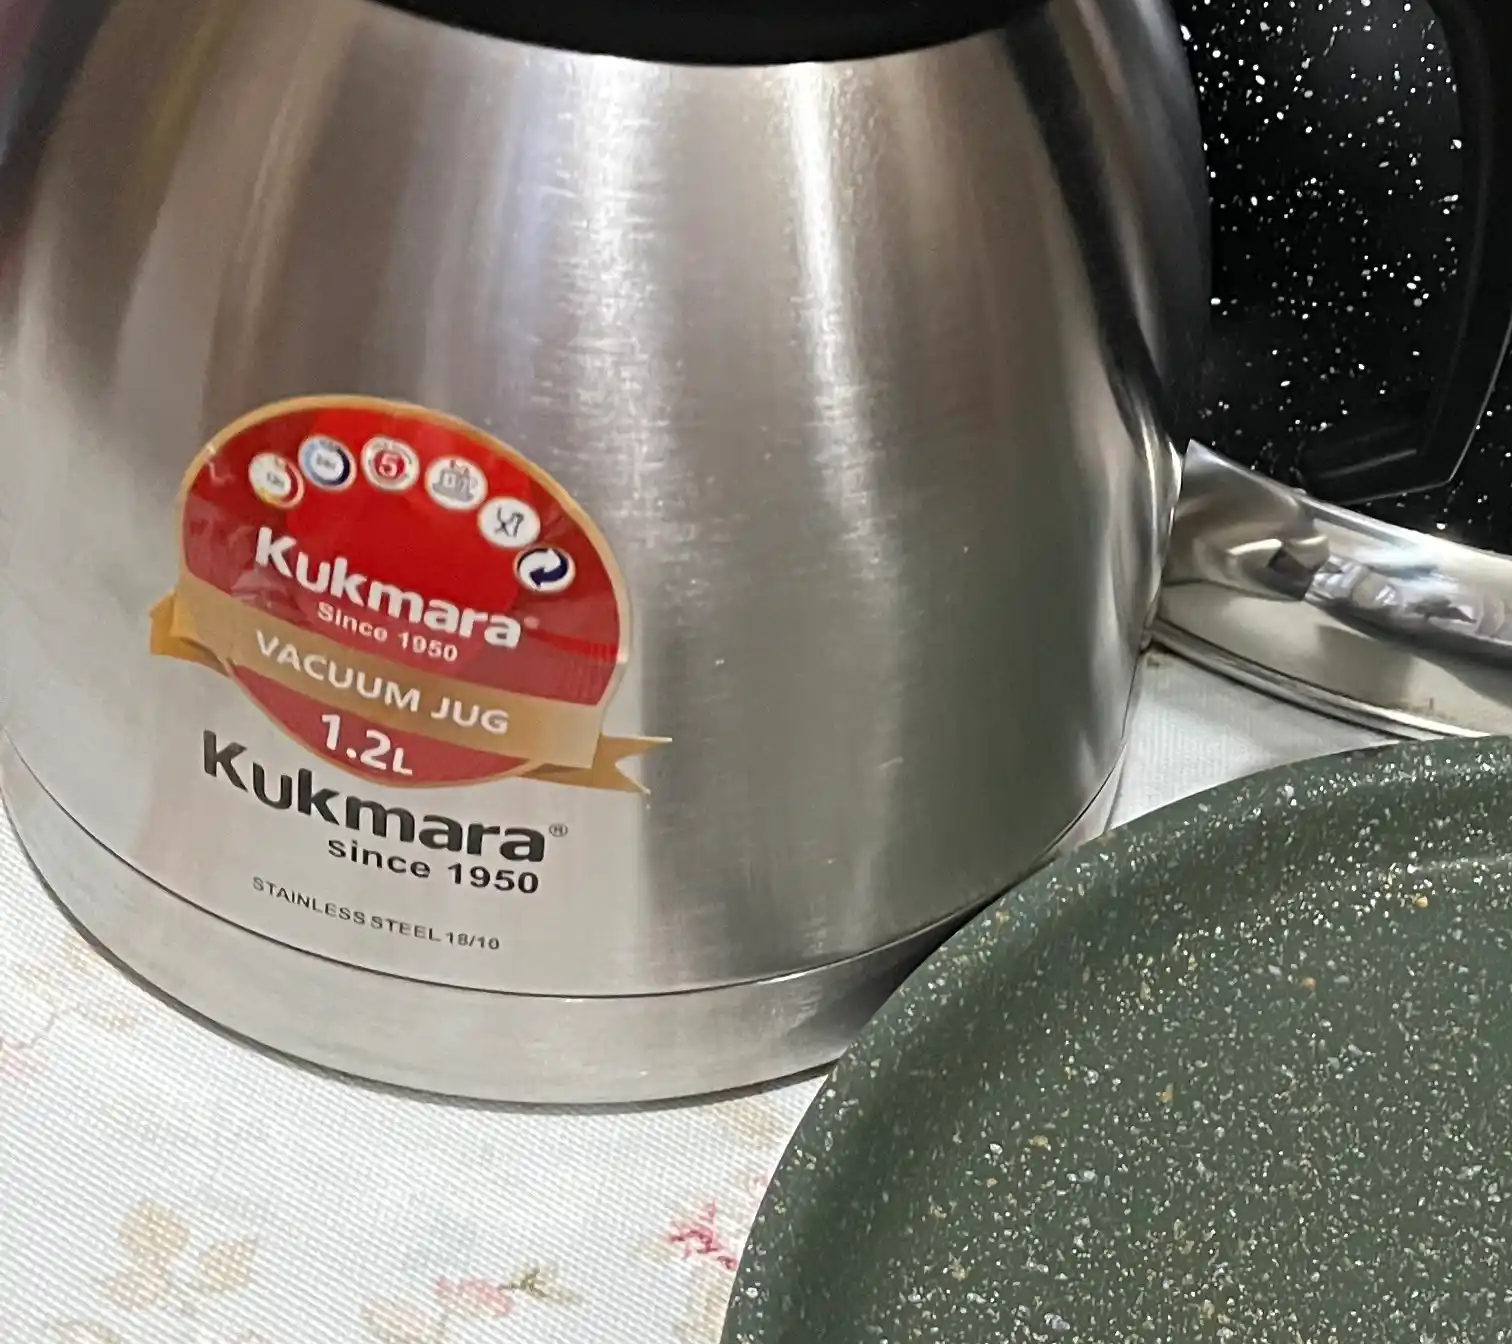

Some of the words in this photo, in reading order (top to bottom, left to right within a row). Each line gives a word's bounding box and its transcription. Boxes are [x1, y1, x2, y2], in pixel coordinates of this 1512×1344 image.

[254, 526, 522, 649] Kukmara
[316, 600, 388, 643] Since
[398, 631, 458, 663] 1950
[255, 628, 421, 713] VACUUM
[431, 696, 510, 736] JUG
[321, 712, 413, 776] 1.2L
[327, 838, 432, 879] since
[447, 862, 540, 895] 1950
[252, 875, 367, 926] STAINLESS
[371, 915, 442, 943] STEEL
[445, 930, 500, 951] 18/10
